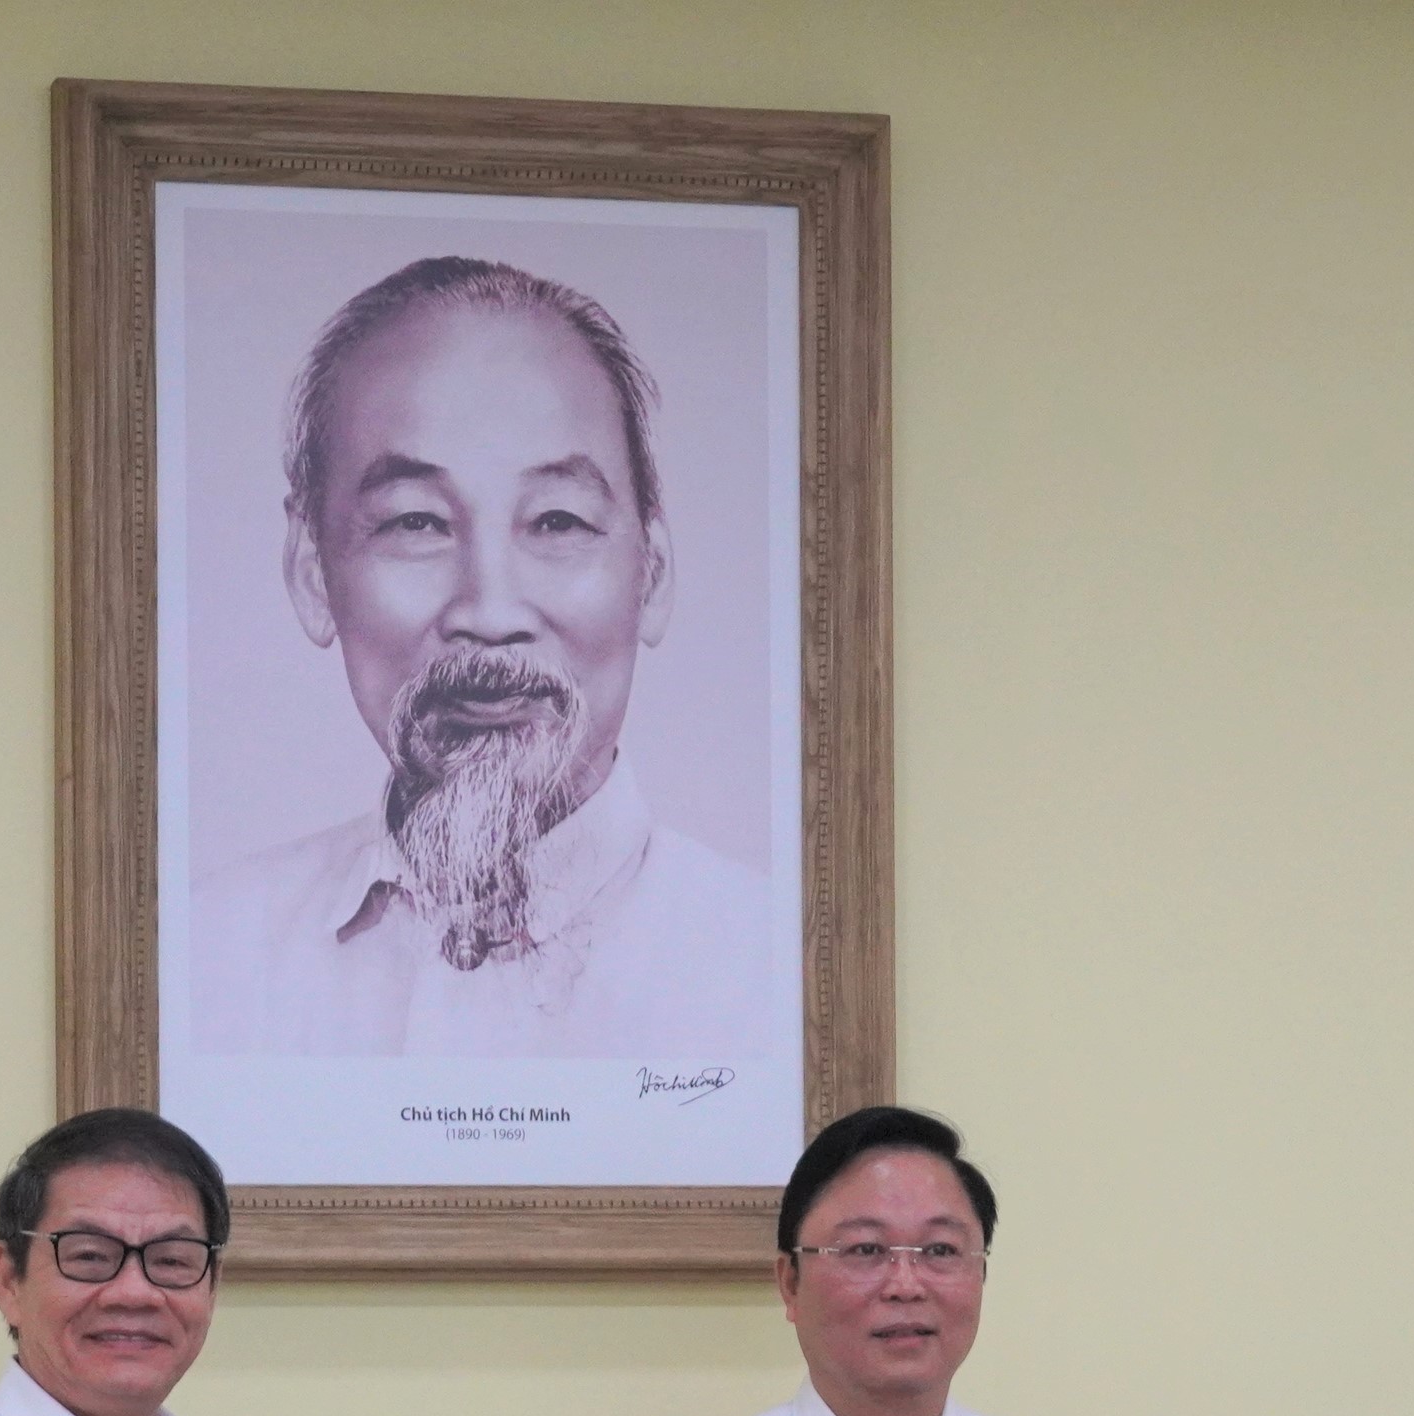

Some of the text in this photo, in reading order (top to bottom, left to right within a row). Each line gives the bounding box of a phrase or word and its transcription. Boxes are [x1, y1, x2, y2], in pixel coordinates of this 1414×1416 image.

[400, 1104, 571, 1126] Chủ tịch Hồ Chí Minh
[445, 1128, 481, 1141] (1890
[492, 1128, 526, 1141] 1969)
